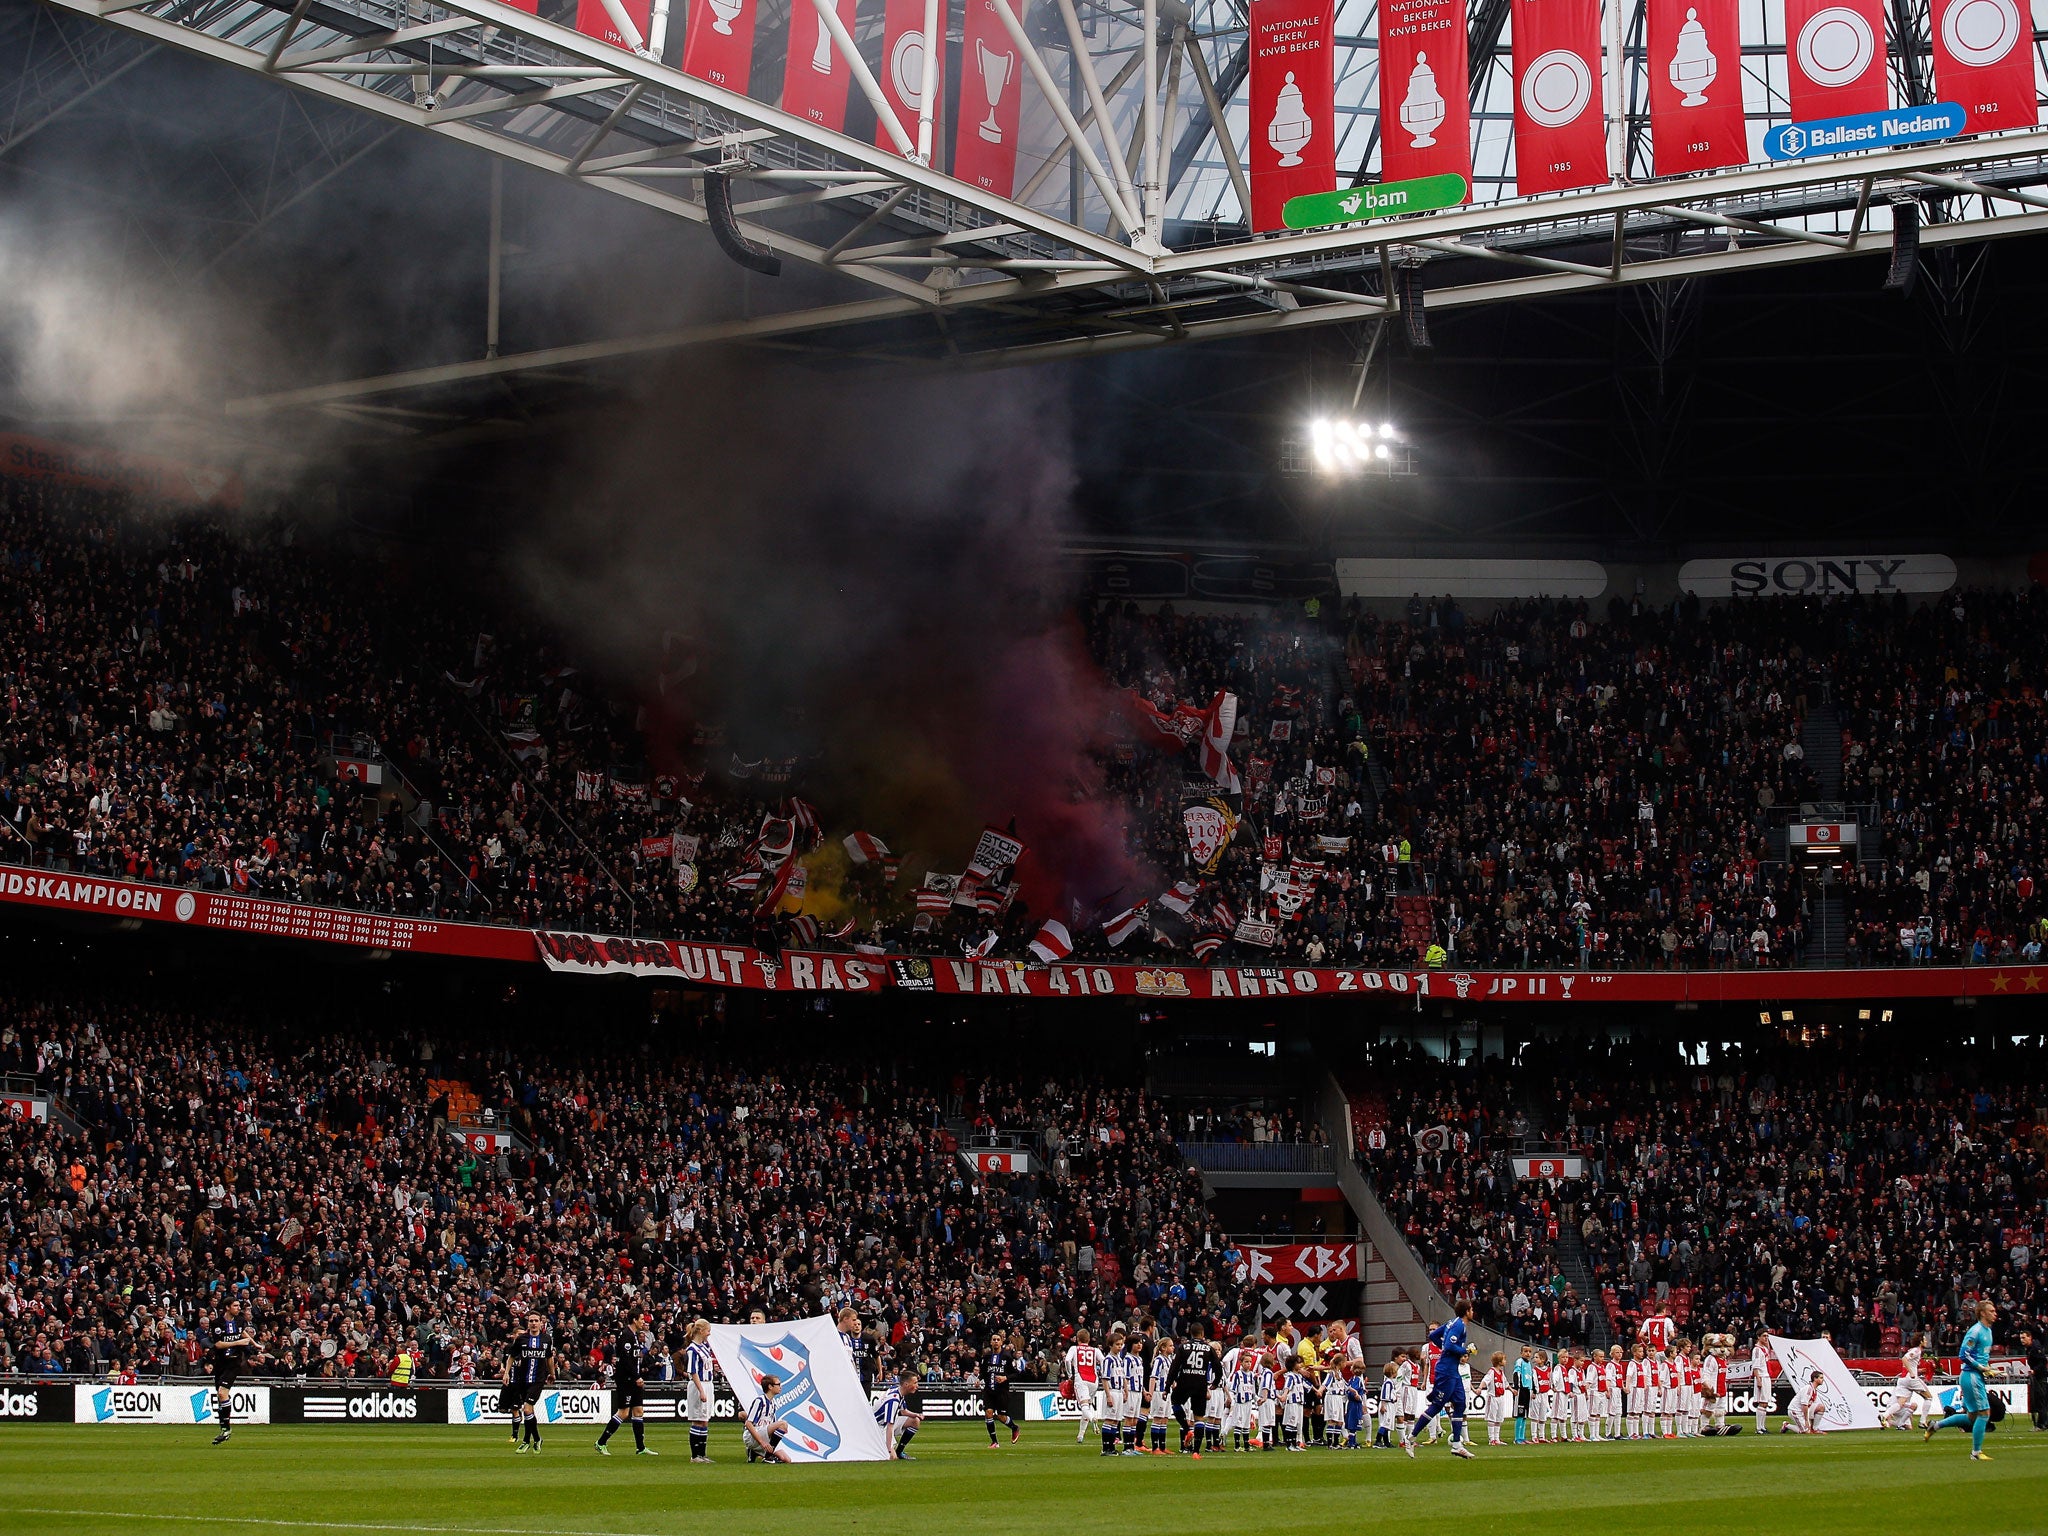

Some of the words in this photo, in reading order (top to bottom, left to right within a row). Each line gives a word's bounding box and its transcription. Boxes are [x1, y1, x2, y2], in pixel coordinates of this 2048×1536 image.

[984, 1, 998, 13] CU
[1390, 0, 1450, 13] NATIONALE
[1261, 16, 1319, 34] NATIONALE
[1403, 9, 1438, 23] BEKER/
[603, 29, 622, 45] 1994
[1273, 30, 1307, 43] BEKER/
[1389, 25, 1417, 37] KNVB
[1421, 19, 1452, 32] BEKER
[1259, 45, 1286, 57] KNVB
[1290, 40, 1320, 53] BEKER
[708, 69, 726, 85] 1993
[807, 107, 824, 122] 1992
[1974, 102, 1999, 115] 1982
[1811, 125, 1877, 147] Ballast
[1882, 115, 1950, 137] Nedam
[1687, 141, 1710, 154] 1983
[1549, 161, 1572, 173] 1985
[977, 175, 994, 188] 1987
[1365, 188, 1407, 210] bam
[1731, 560, 1906, 592] SONY
[982, 833, 1019, 855] STOP
[209, 907, 227, 916] 1919
[230, 910, 248, 919] 1934
[251, 912, 269, 922] 1947
[271, 915, 289, 924] 1966
[292, 917, 310, 927] 1970
[313, 920, 331, 929] 1977
[333, 923, 350, 932] 1982
[352, 925, 370, 935] 1990
[373, 928, 390, 937] 1996
[392, 931, 413, 939] 2004
[210, 897, 229, 907] 1918
[232, 900, 250, 910] 1932
[252, 903, 271, 912] 1939
[273, 905, 291, 915] 1960
[293, 908, 311, 917] 1968
[314, 911, 332, 920] 1973
[334, 914, 351, 923] 1980
[354, 916, 371, 926] 1985
[374, 919, 391, 928] 1995
[393, 922, 414, 931] 2002
[207, 916, 226, 926] 1931
[229, 919, 247, 929] 1937
[250, 922, 268, 931] 1957
[270, 924, 288, 933] 1967
[291, 926, 308, 936] 1972
[311, 929, 329, 939] 1979
[331, 932, 348, 941] 1983
[351, 934, 369, 944] 1994
[371, 937, 389, 946] 1998
[391, 940, 411, 948] 2011
[677, 945, 745, 985] ULT
[790, 956, 872, 990] RAS
[950, 961, 1032, 995] VAK
[1049, 967, 1115, 995] 410
[1336, 972, 1429, 996] 2001
[1487, 978, 1517, 995] JP
[1590, 976, 1613, 984] 1987
[1249, 1249, 1275, 1283] R
[1294, 1244, 1353, 1279] CBS
[1653, 1323, 1660, 1338] 4
[1078, 1350, 1094, 1366] 39
[1187, 1351, 1204, 1369] 46
[104, 1391, 162, 1414] AEGON
[202, 1391, 257, 1414] AEON
[349, 1391, 417, 1418] adidas
[554, 1394, 601, 1414] AEGON
[1049, 1396, 1098, 1415] AEGN
